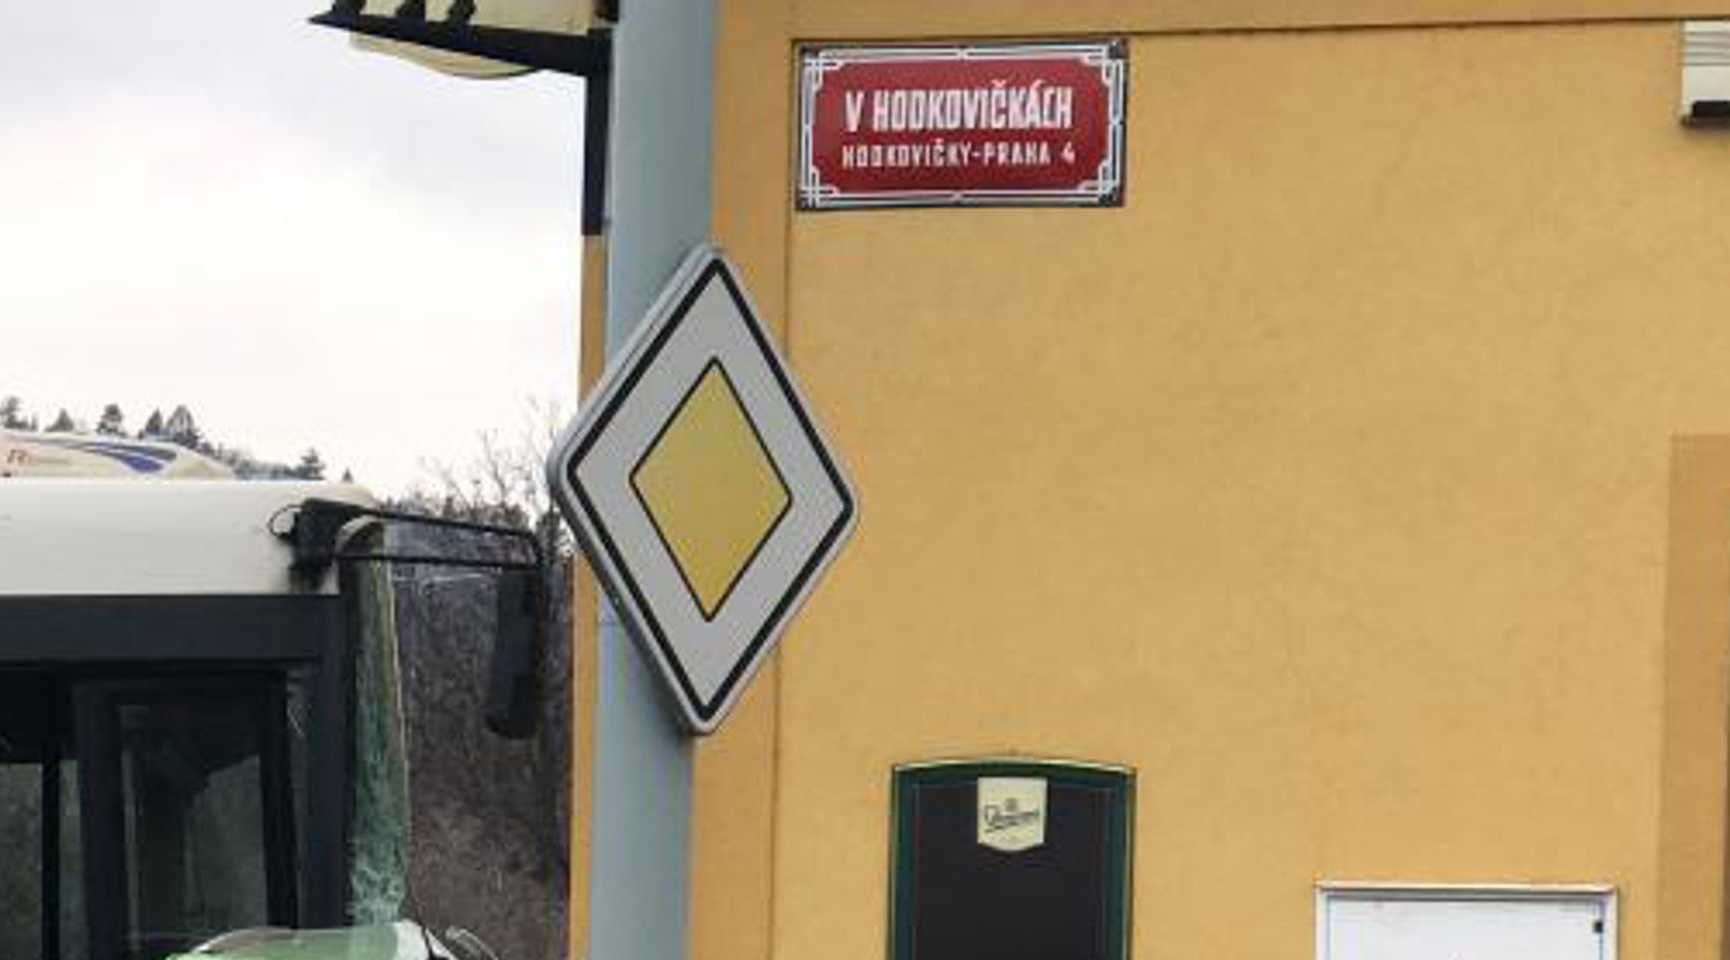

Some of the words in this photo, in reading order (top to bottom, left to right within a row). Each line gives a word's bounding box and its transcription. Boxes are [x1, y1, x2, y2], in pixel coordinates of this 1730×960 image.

[845, 92, 864, 132] V
[872, 79, 1073, 131] HODKOVIČKÁCH
[842, 139, 1050, 169] HODKOVIČKY-PRAHA
[1061, 141, 1076, 166] 4
